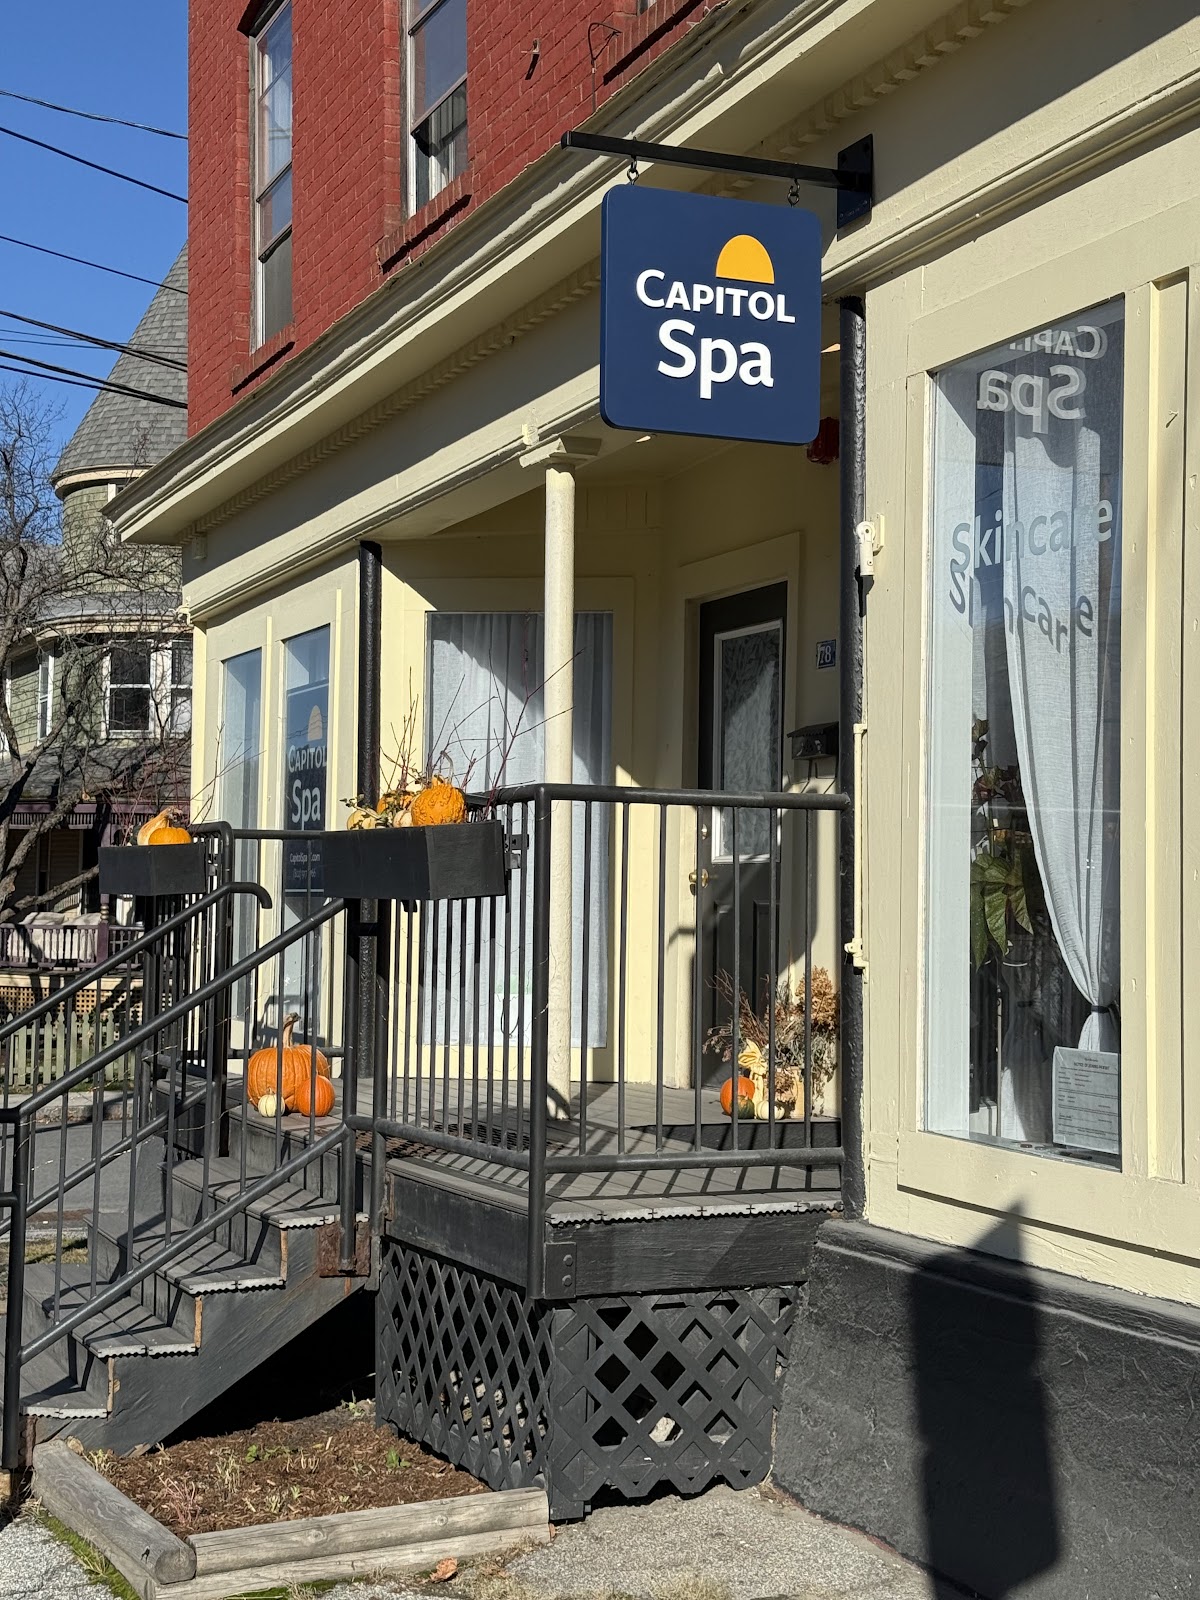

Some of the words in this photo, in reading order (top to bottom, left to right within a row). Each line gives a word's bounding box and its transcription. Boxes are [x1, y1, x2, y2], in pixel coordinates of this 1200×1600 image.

[635, 268, 796, 323] CAPITOL
[657, 318, 774, 400] Spa
[819, 645, 832, 664] 78
[288, 744, 328, 773] CAPITOL
[291, 779, 321, 831] Spa
